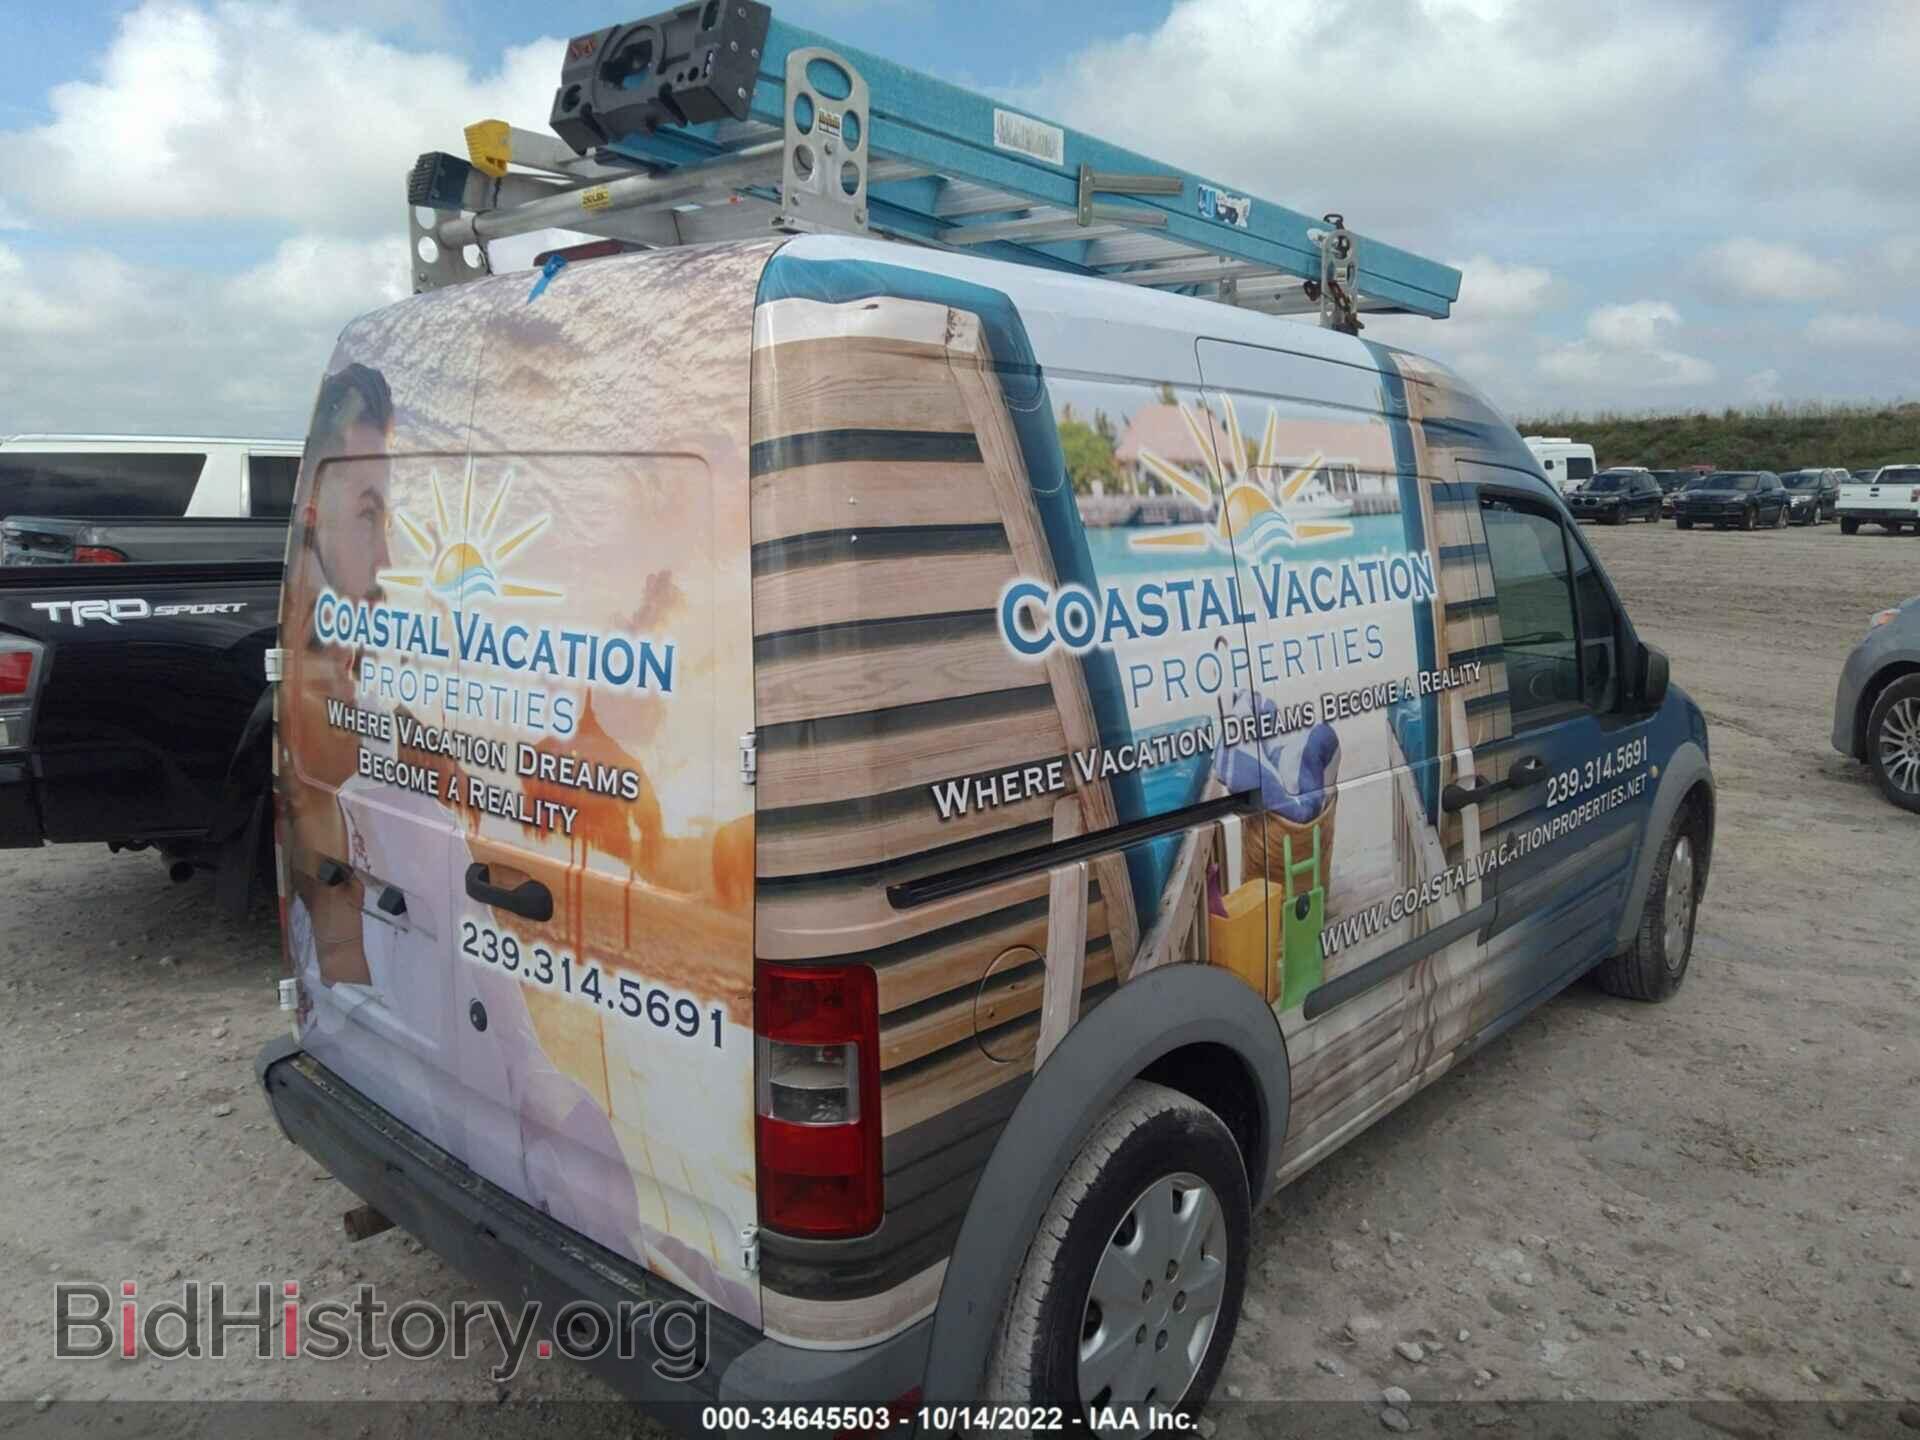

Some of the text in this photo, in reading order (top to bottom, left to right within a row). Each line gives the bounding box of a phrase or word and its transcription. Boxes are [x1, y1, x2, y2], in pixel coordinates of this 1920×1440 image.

[31, 597, 248, 627] TRD SPORT
[316, 593, 676, 693] COASTAL VACATION
[1001, 555, 1437, 656] COASTAL VACATION
[360, 661, 575, 735] PROPERTIES
[1130, 622, 1384, 709] PROPERTIES
[326, 698, 641, 800] WHERE VACATION DREAMS
[931, 661, 1482, 820] WHERE VACATION DREAMS BECOME A REALITY
[1545, 734, 1649, 809] 239.314.5691
[357, 746, 579, 836] BECOME A REALITY
[460, 920, 725, 1049] 239.314.5691
